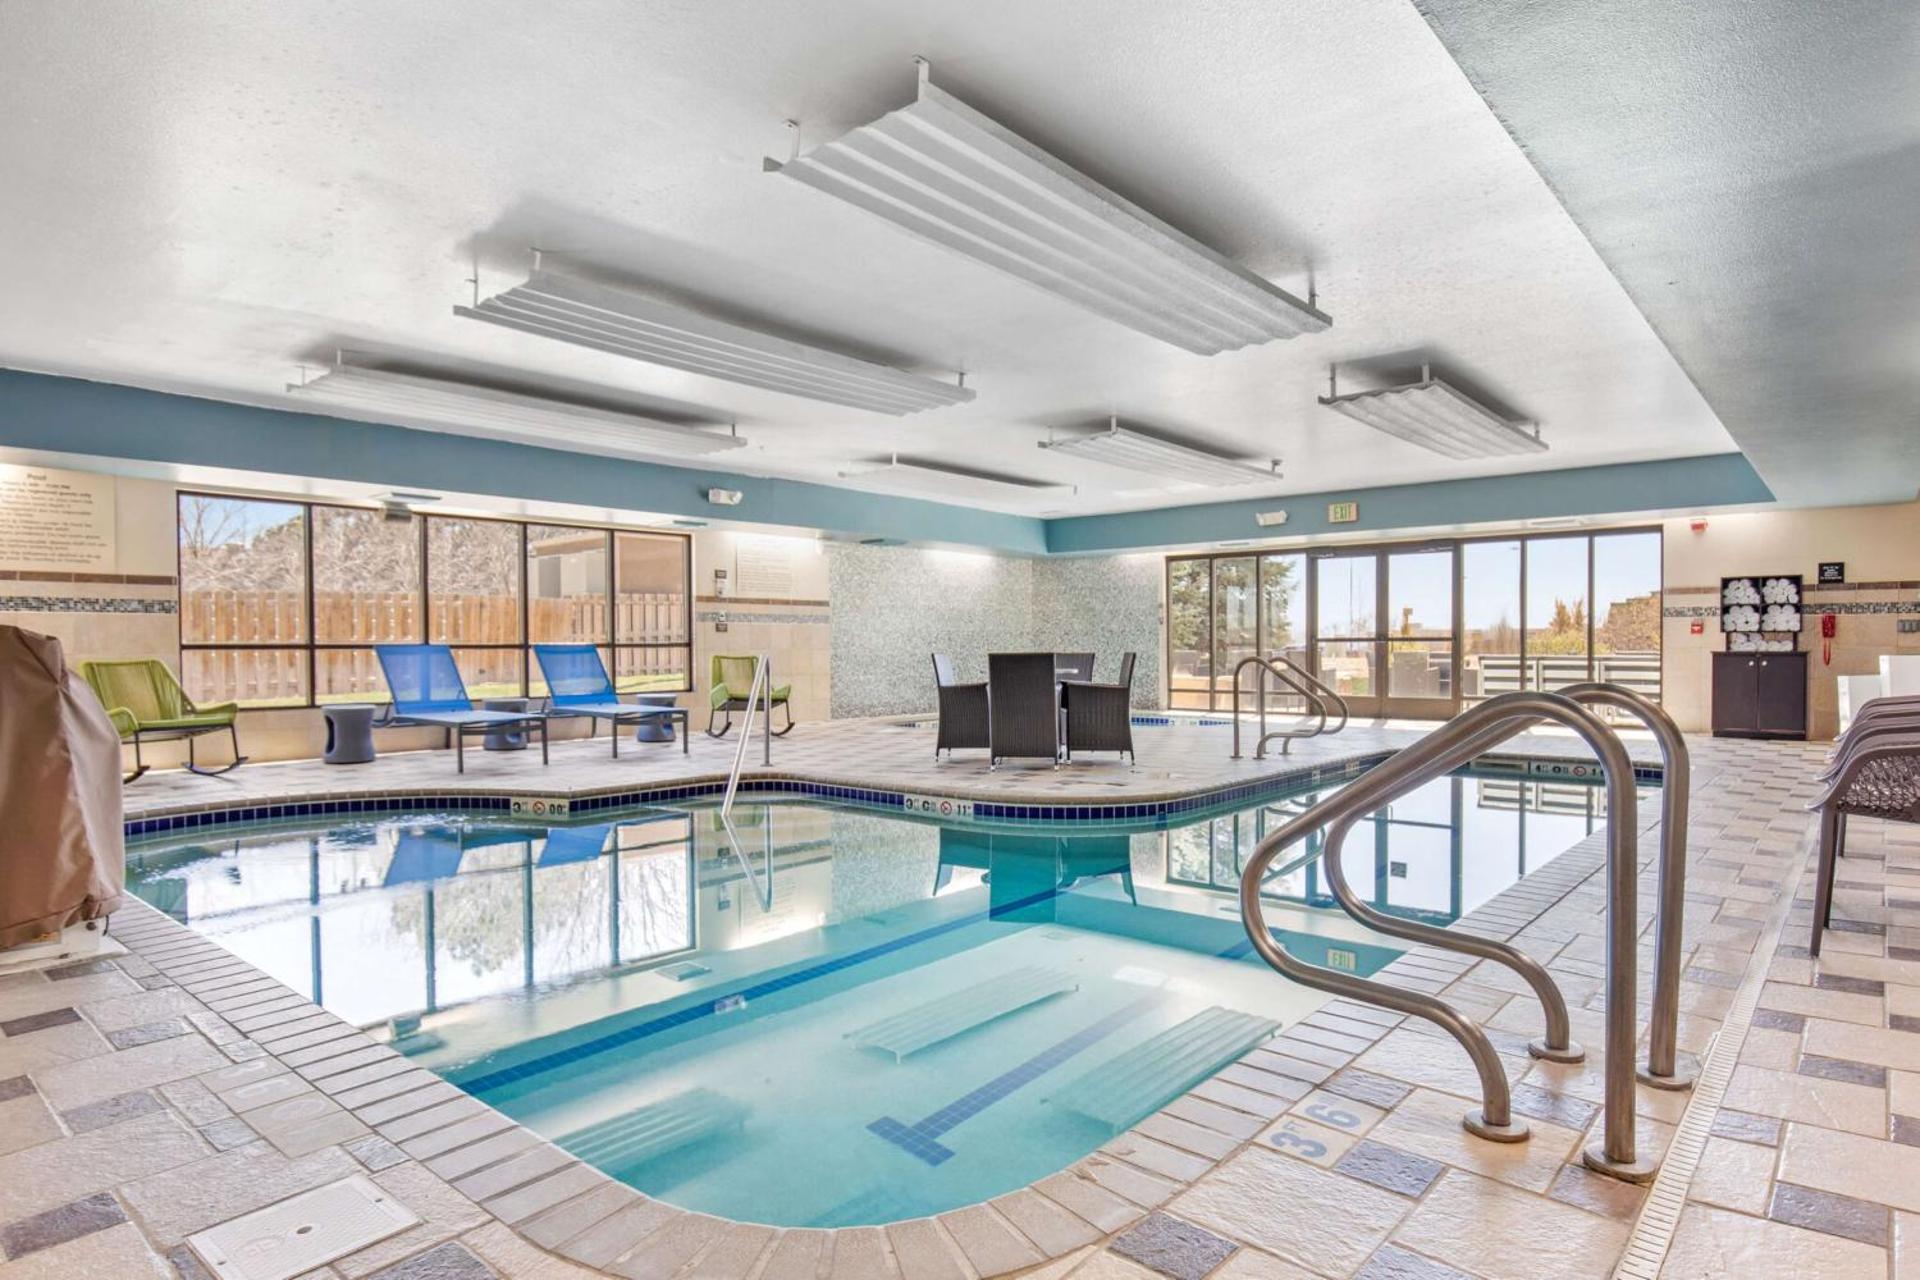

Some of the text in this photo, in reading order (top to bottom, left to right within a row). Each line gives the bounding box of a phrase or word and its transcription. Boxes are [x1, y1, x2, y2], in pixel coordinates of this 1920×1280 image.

[1333, 502, 1352, 521] EXIT
[512, 801, 521, 814] 3
[1270, 1131, 1327, 1158] 3
[1304, 1103, 1361, 1128] 6
